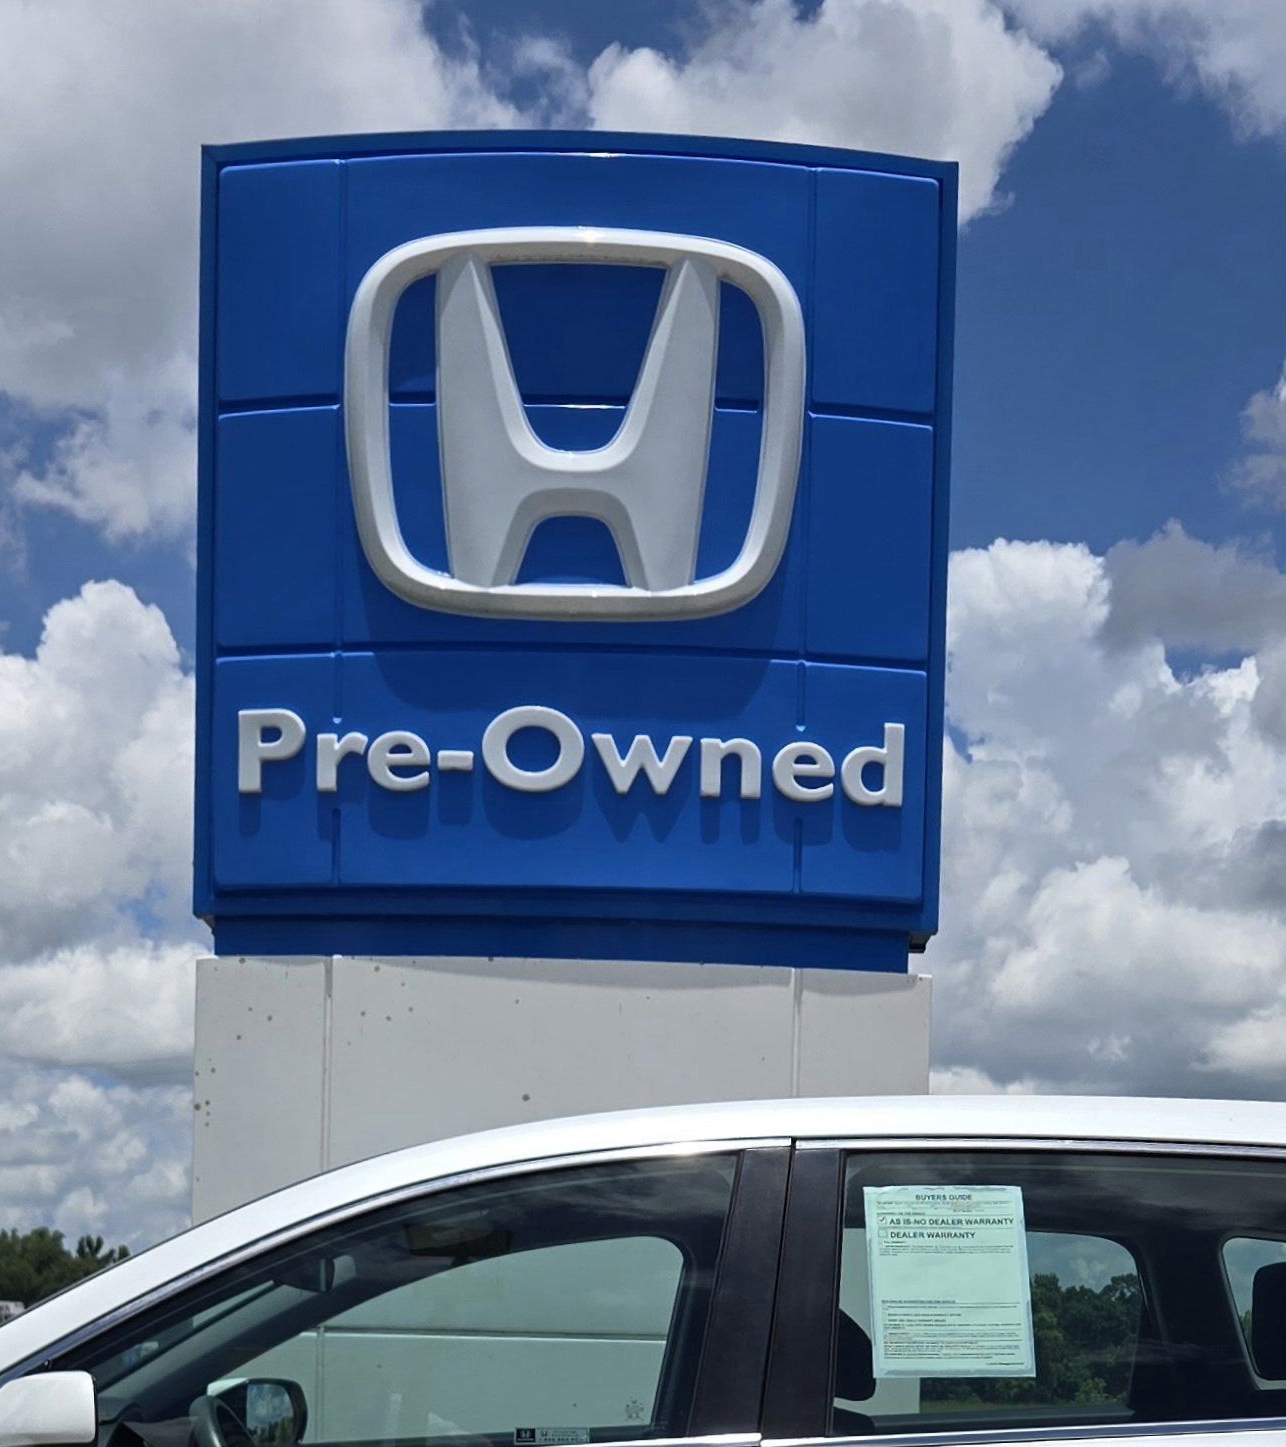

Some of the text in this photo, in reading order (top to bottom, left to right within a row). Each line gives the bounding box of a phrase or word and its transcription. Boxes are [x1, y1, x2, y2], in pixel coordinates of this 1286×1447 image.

[236, 704, 905, 806] Pre-Owned
[965, 1217, 1014, 1225] WARRANTY
[890, 1231, 976, 1239] DEALER WARRANTY
